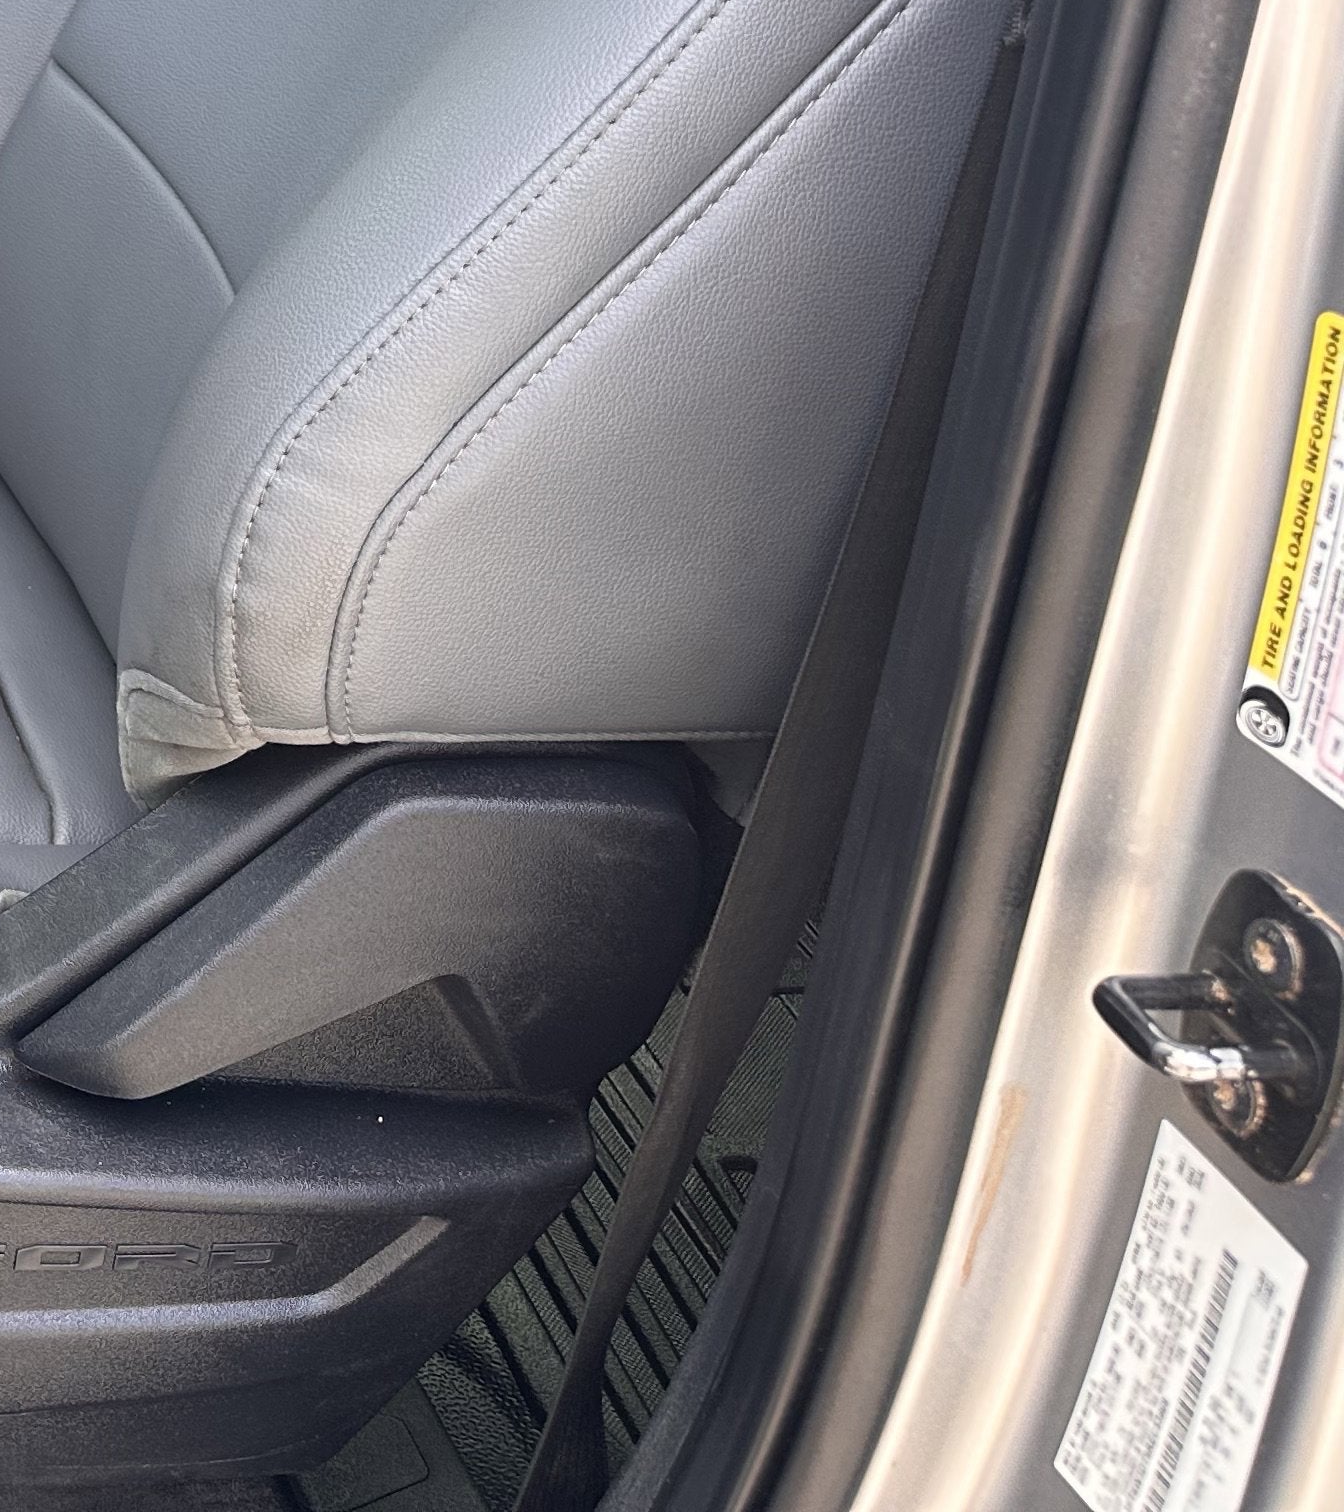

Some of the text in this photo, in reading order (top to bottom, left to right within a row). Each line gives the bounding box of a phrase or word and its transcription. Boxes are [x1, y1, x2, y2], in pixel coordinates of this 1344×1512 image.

[1260, 325, 1342, 671] TIRE AND LOADING INFORMATION
